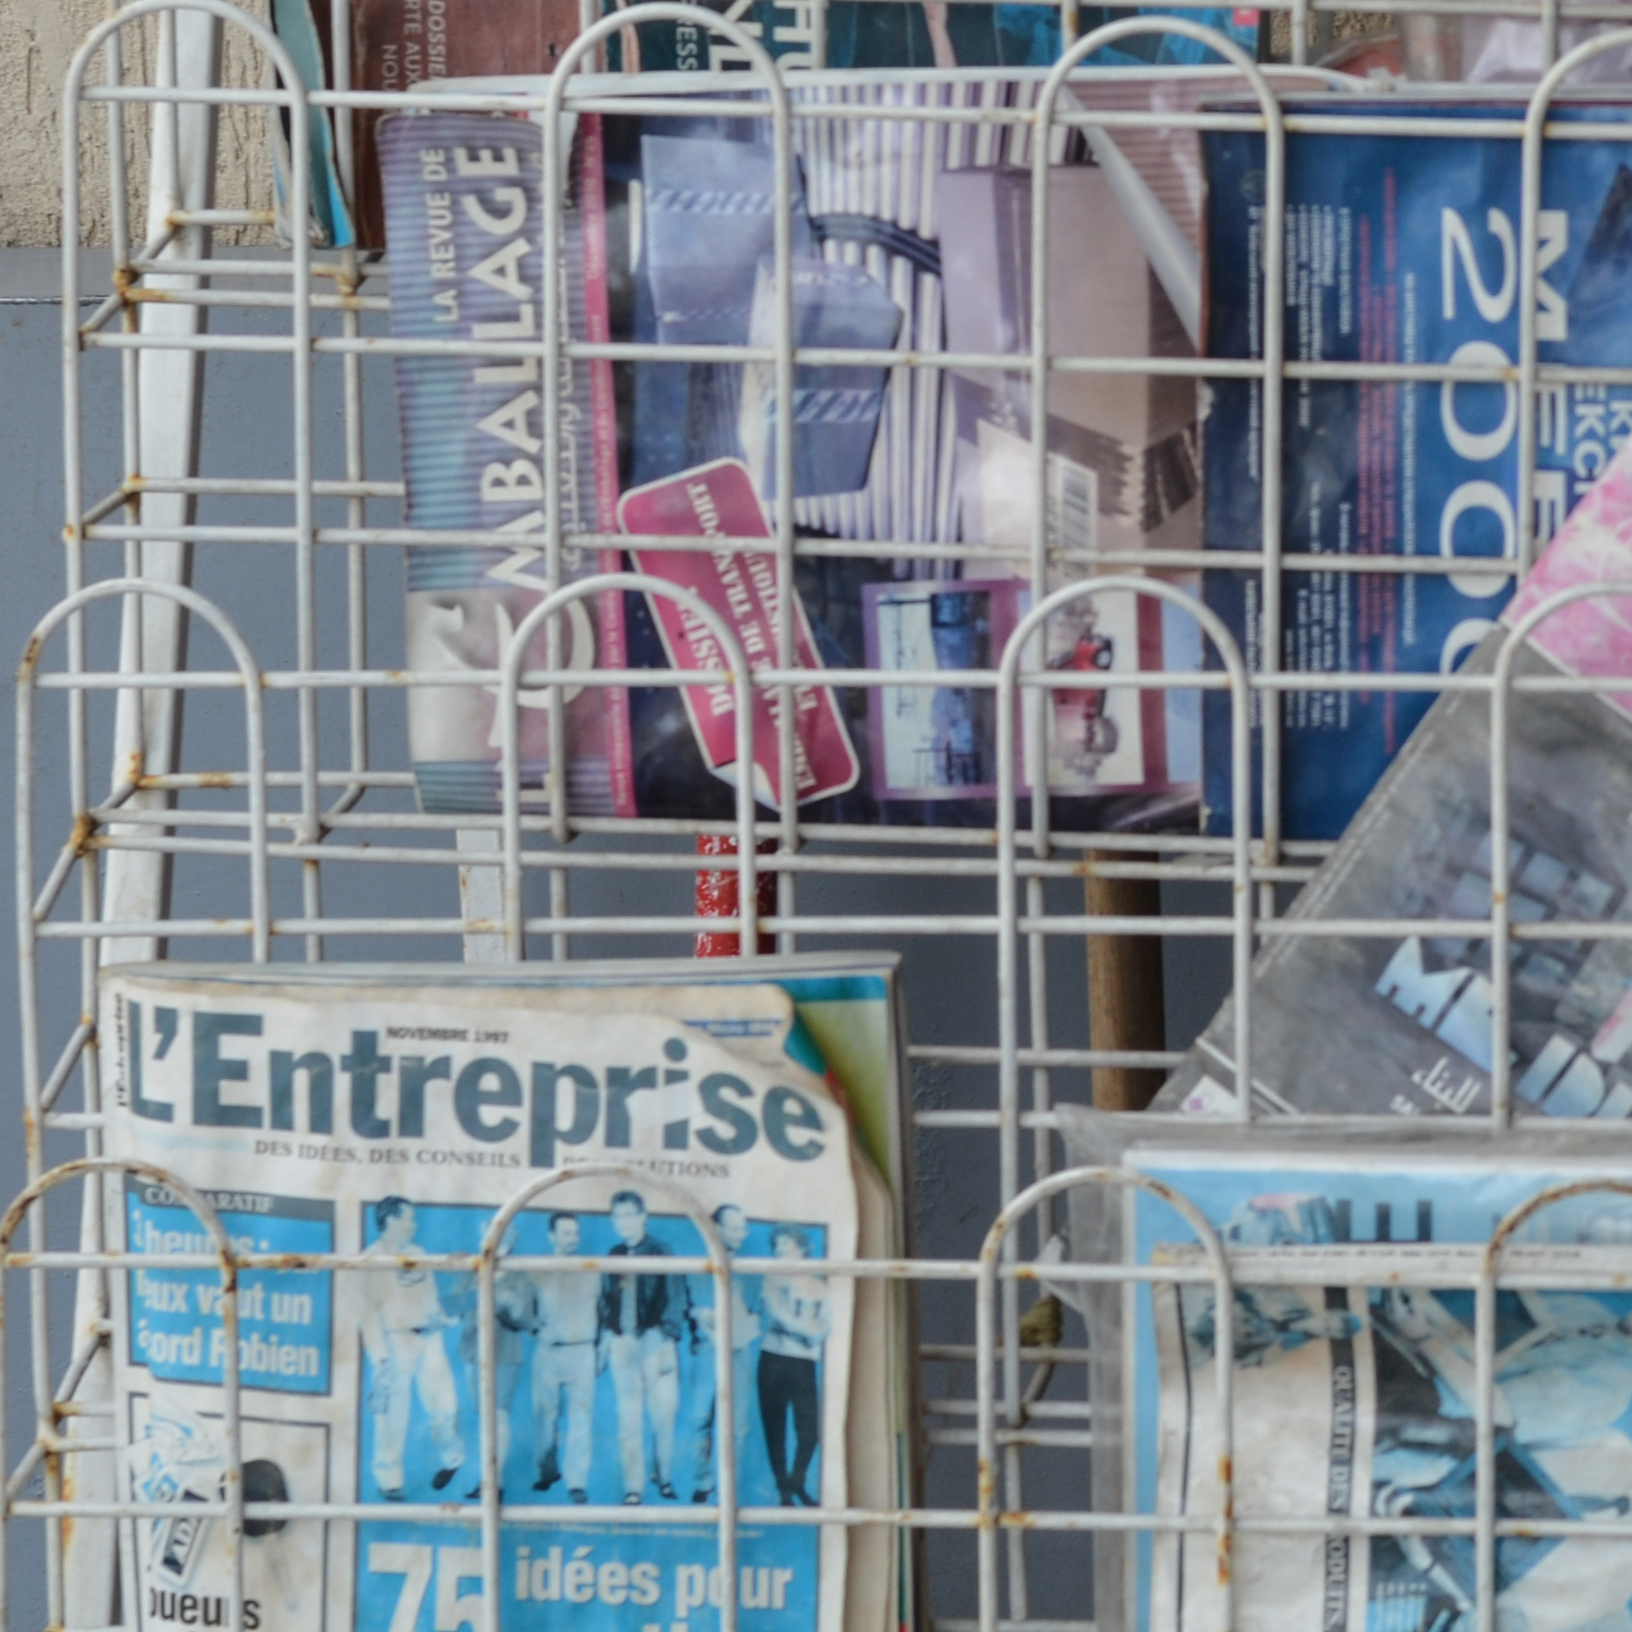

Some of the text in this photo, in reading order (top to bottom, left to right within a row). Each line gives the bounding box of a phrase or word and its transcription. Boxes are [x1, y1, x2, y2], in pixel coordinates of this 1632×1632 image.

[418, 146, 460, 322] LA REVUE DE
[385, 1024, 470, 1045] NOVEMBRE
[124, 996, 828, 1172] L'Entreprise
[254, 1138, 293, 1159] DES
[370, 1145, 409, 1167] DES
[413, 1147, 521, 1171] CONSEILS
[271, 1292, 312, 1328] un
[366, 1538, 484, 1632] 75
[512, 1544, 659, 1606] idées
